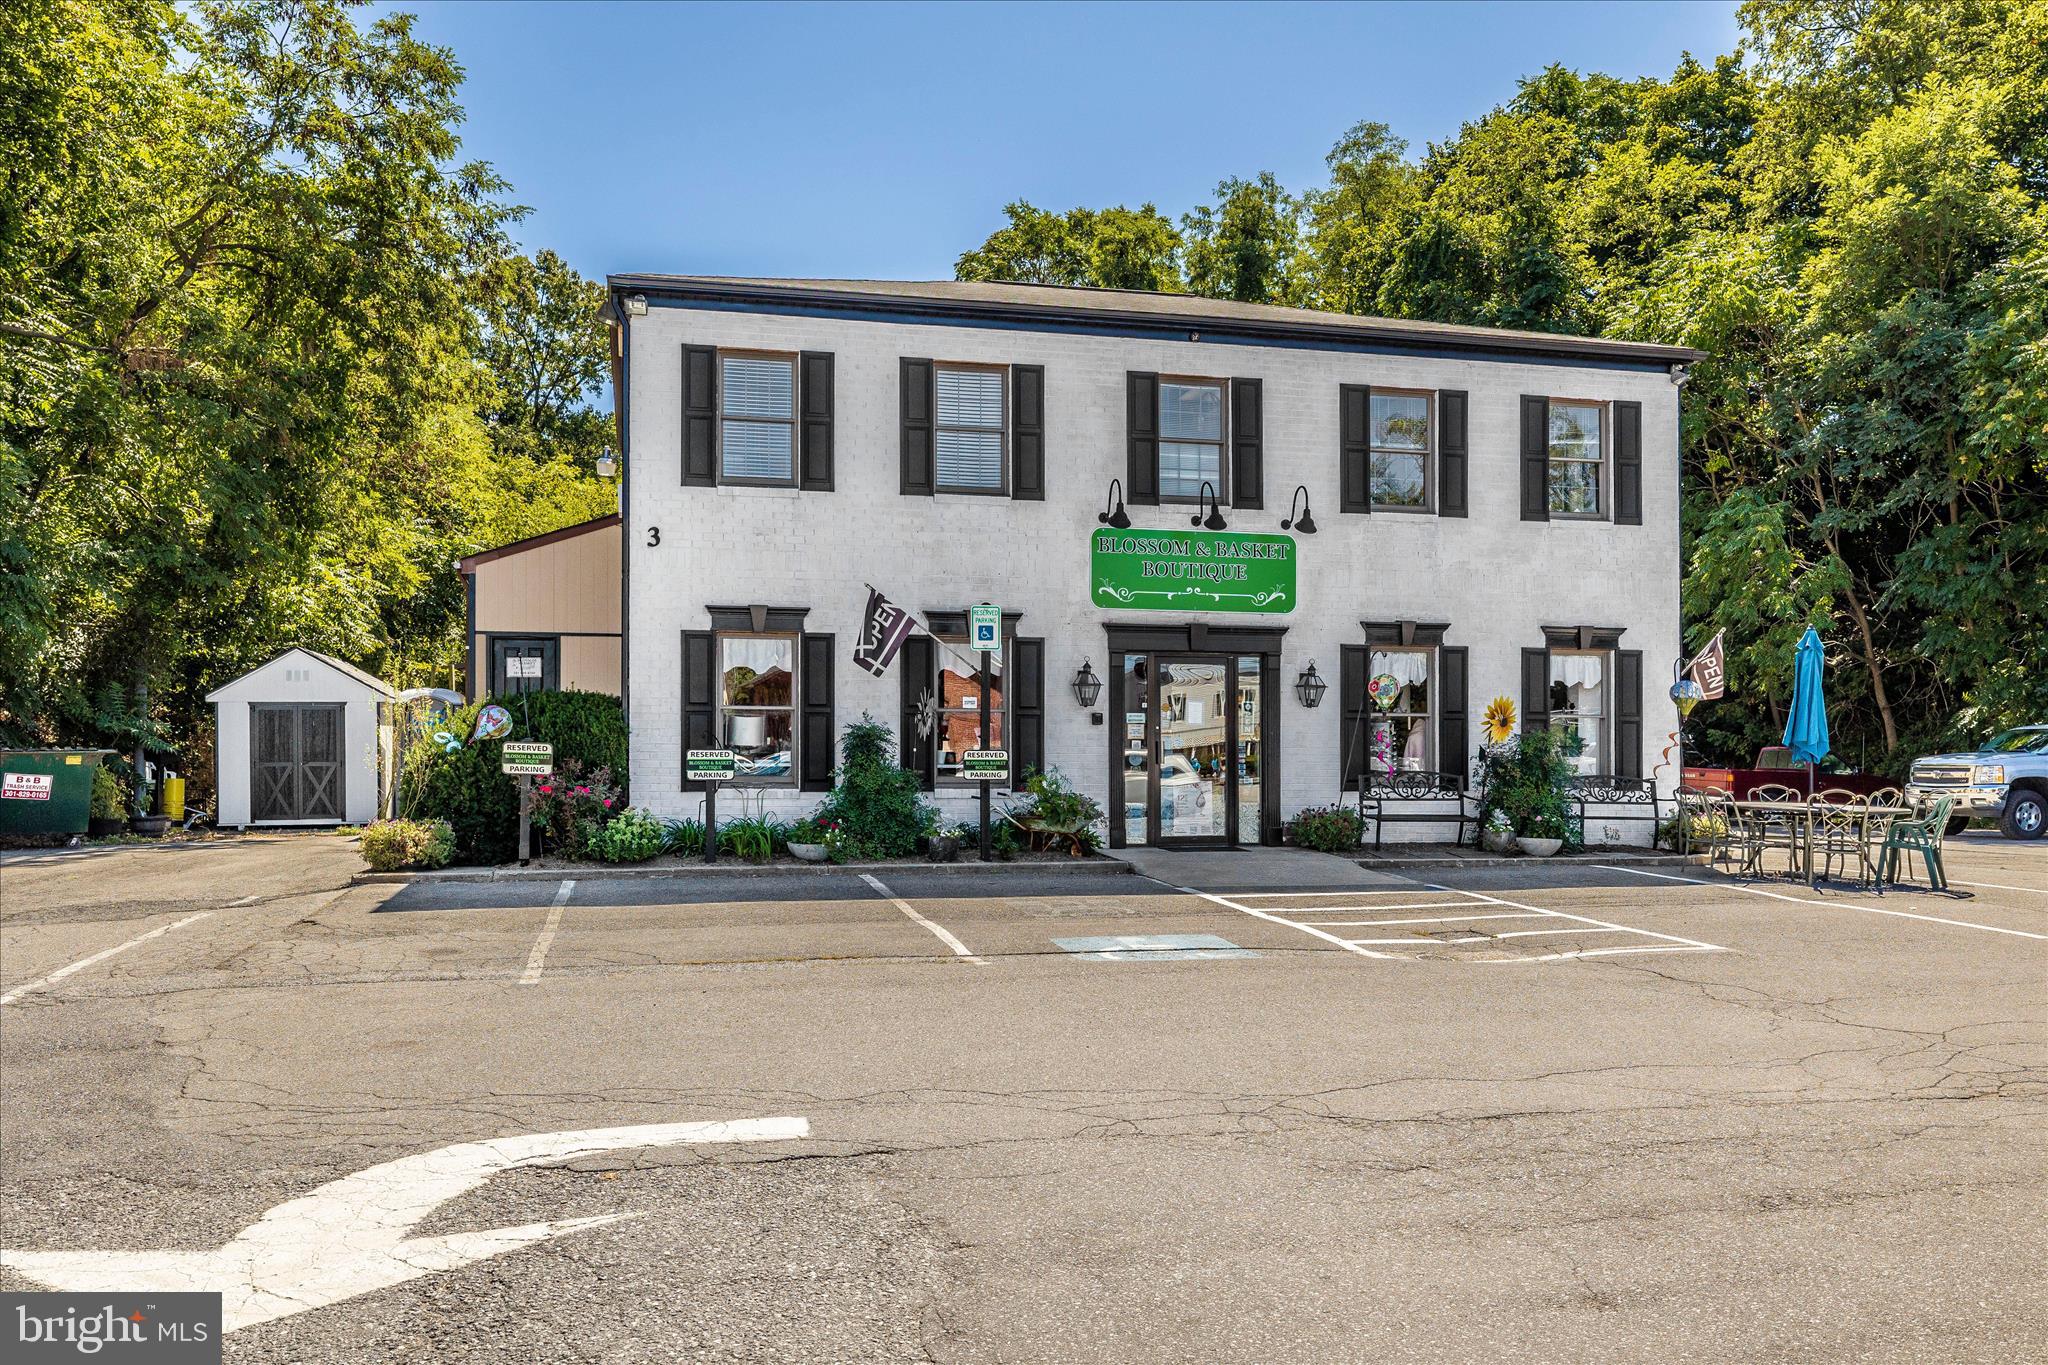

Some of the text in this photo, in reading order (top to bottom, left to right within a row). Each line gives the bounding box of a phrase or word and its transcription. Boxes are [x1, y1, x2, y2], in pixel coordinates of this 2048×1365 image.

[647, 526, 661, 547] 3
[1097, 537, 1290, 560] BLOSSOM & BASKET
[1142, 560, 1248, 583] BOUTIQUE
[506, 744, 548, 752] RESERVED
[509, 765, 545, 773] PARKING
